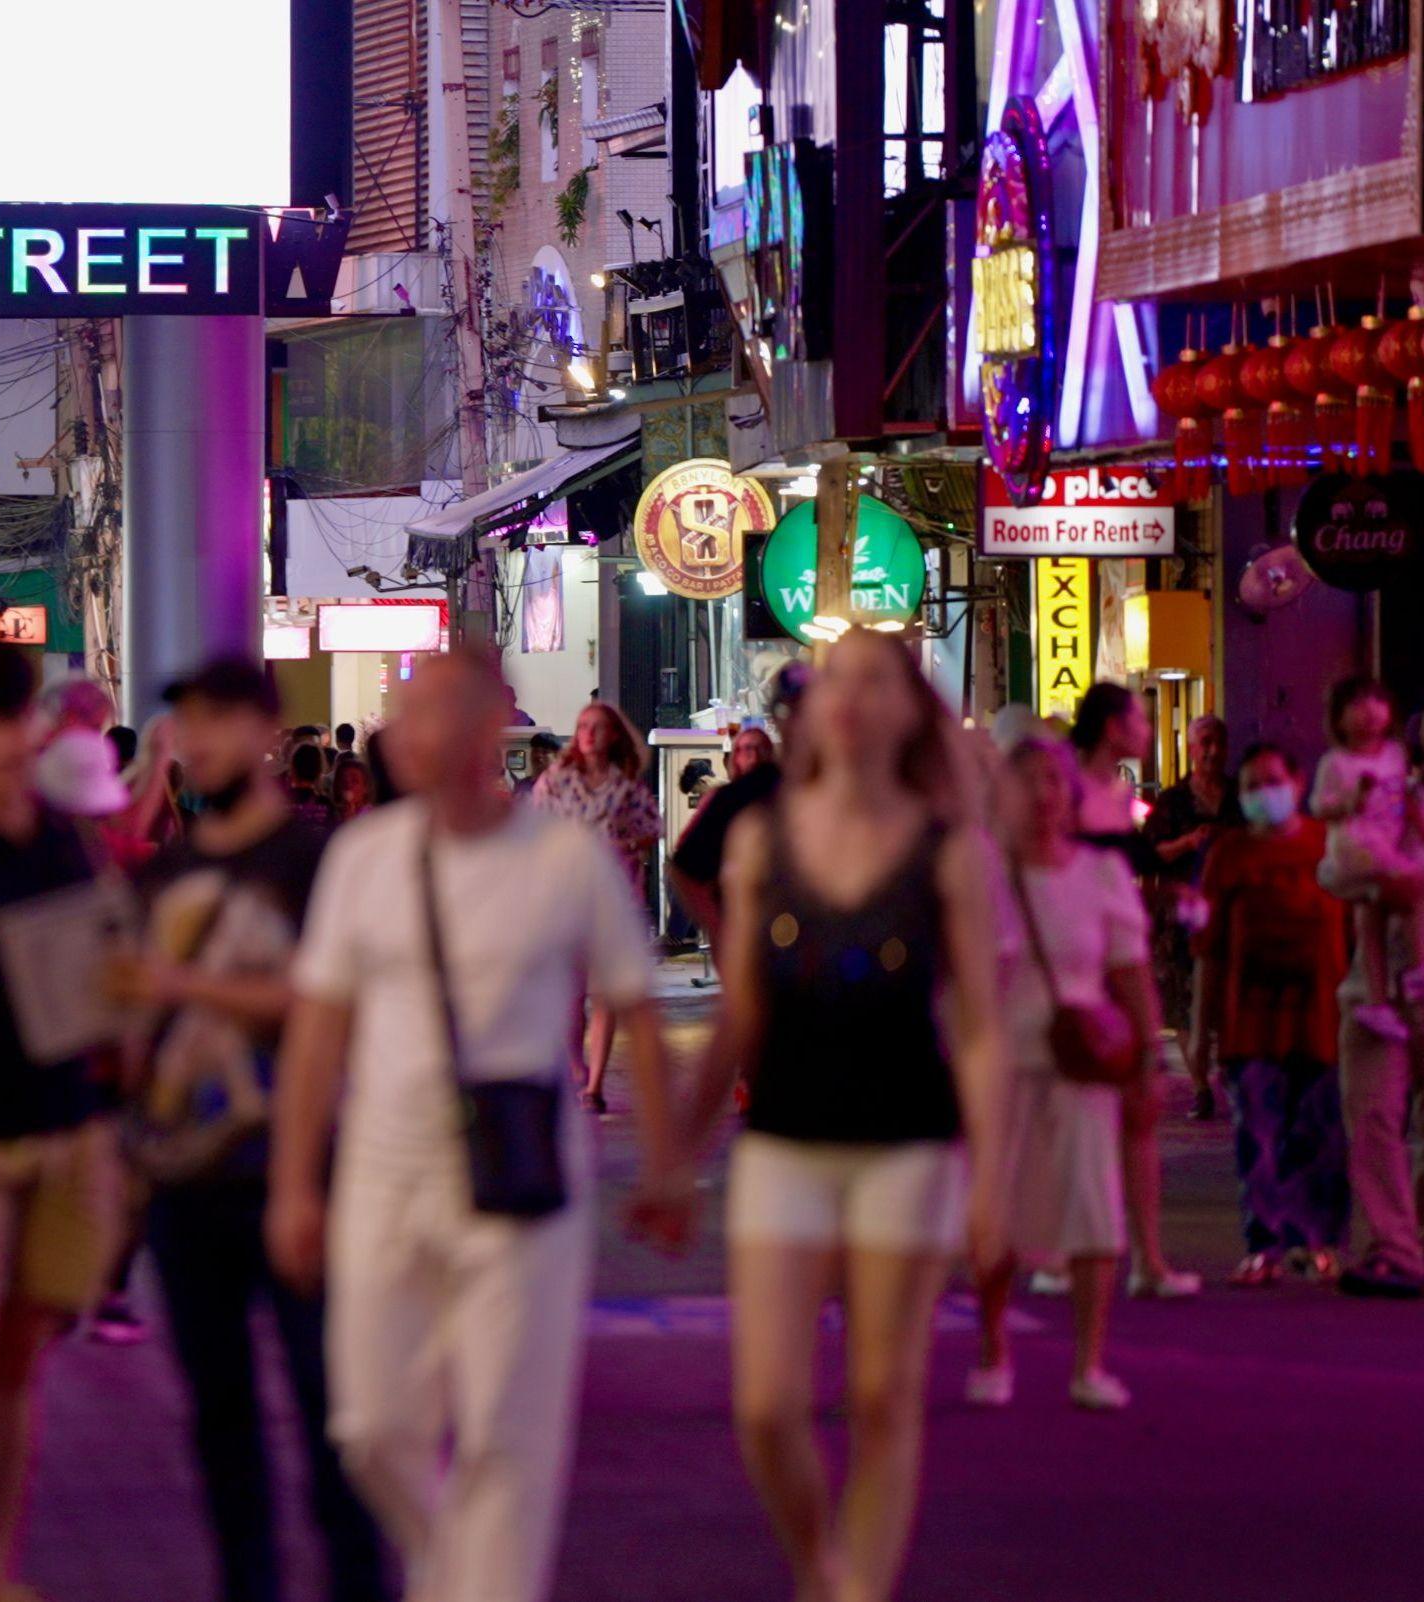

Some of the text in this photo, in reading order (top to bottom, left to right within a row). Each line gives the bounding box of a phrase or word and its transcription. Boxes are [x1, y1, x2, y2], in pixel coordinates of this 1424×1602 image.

[993, 519, 1140, 542] Room For Rent
[1315, 524, 1406, 555] Chang
